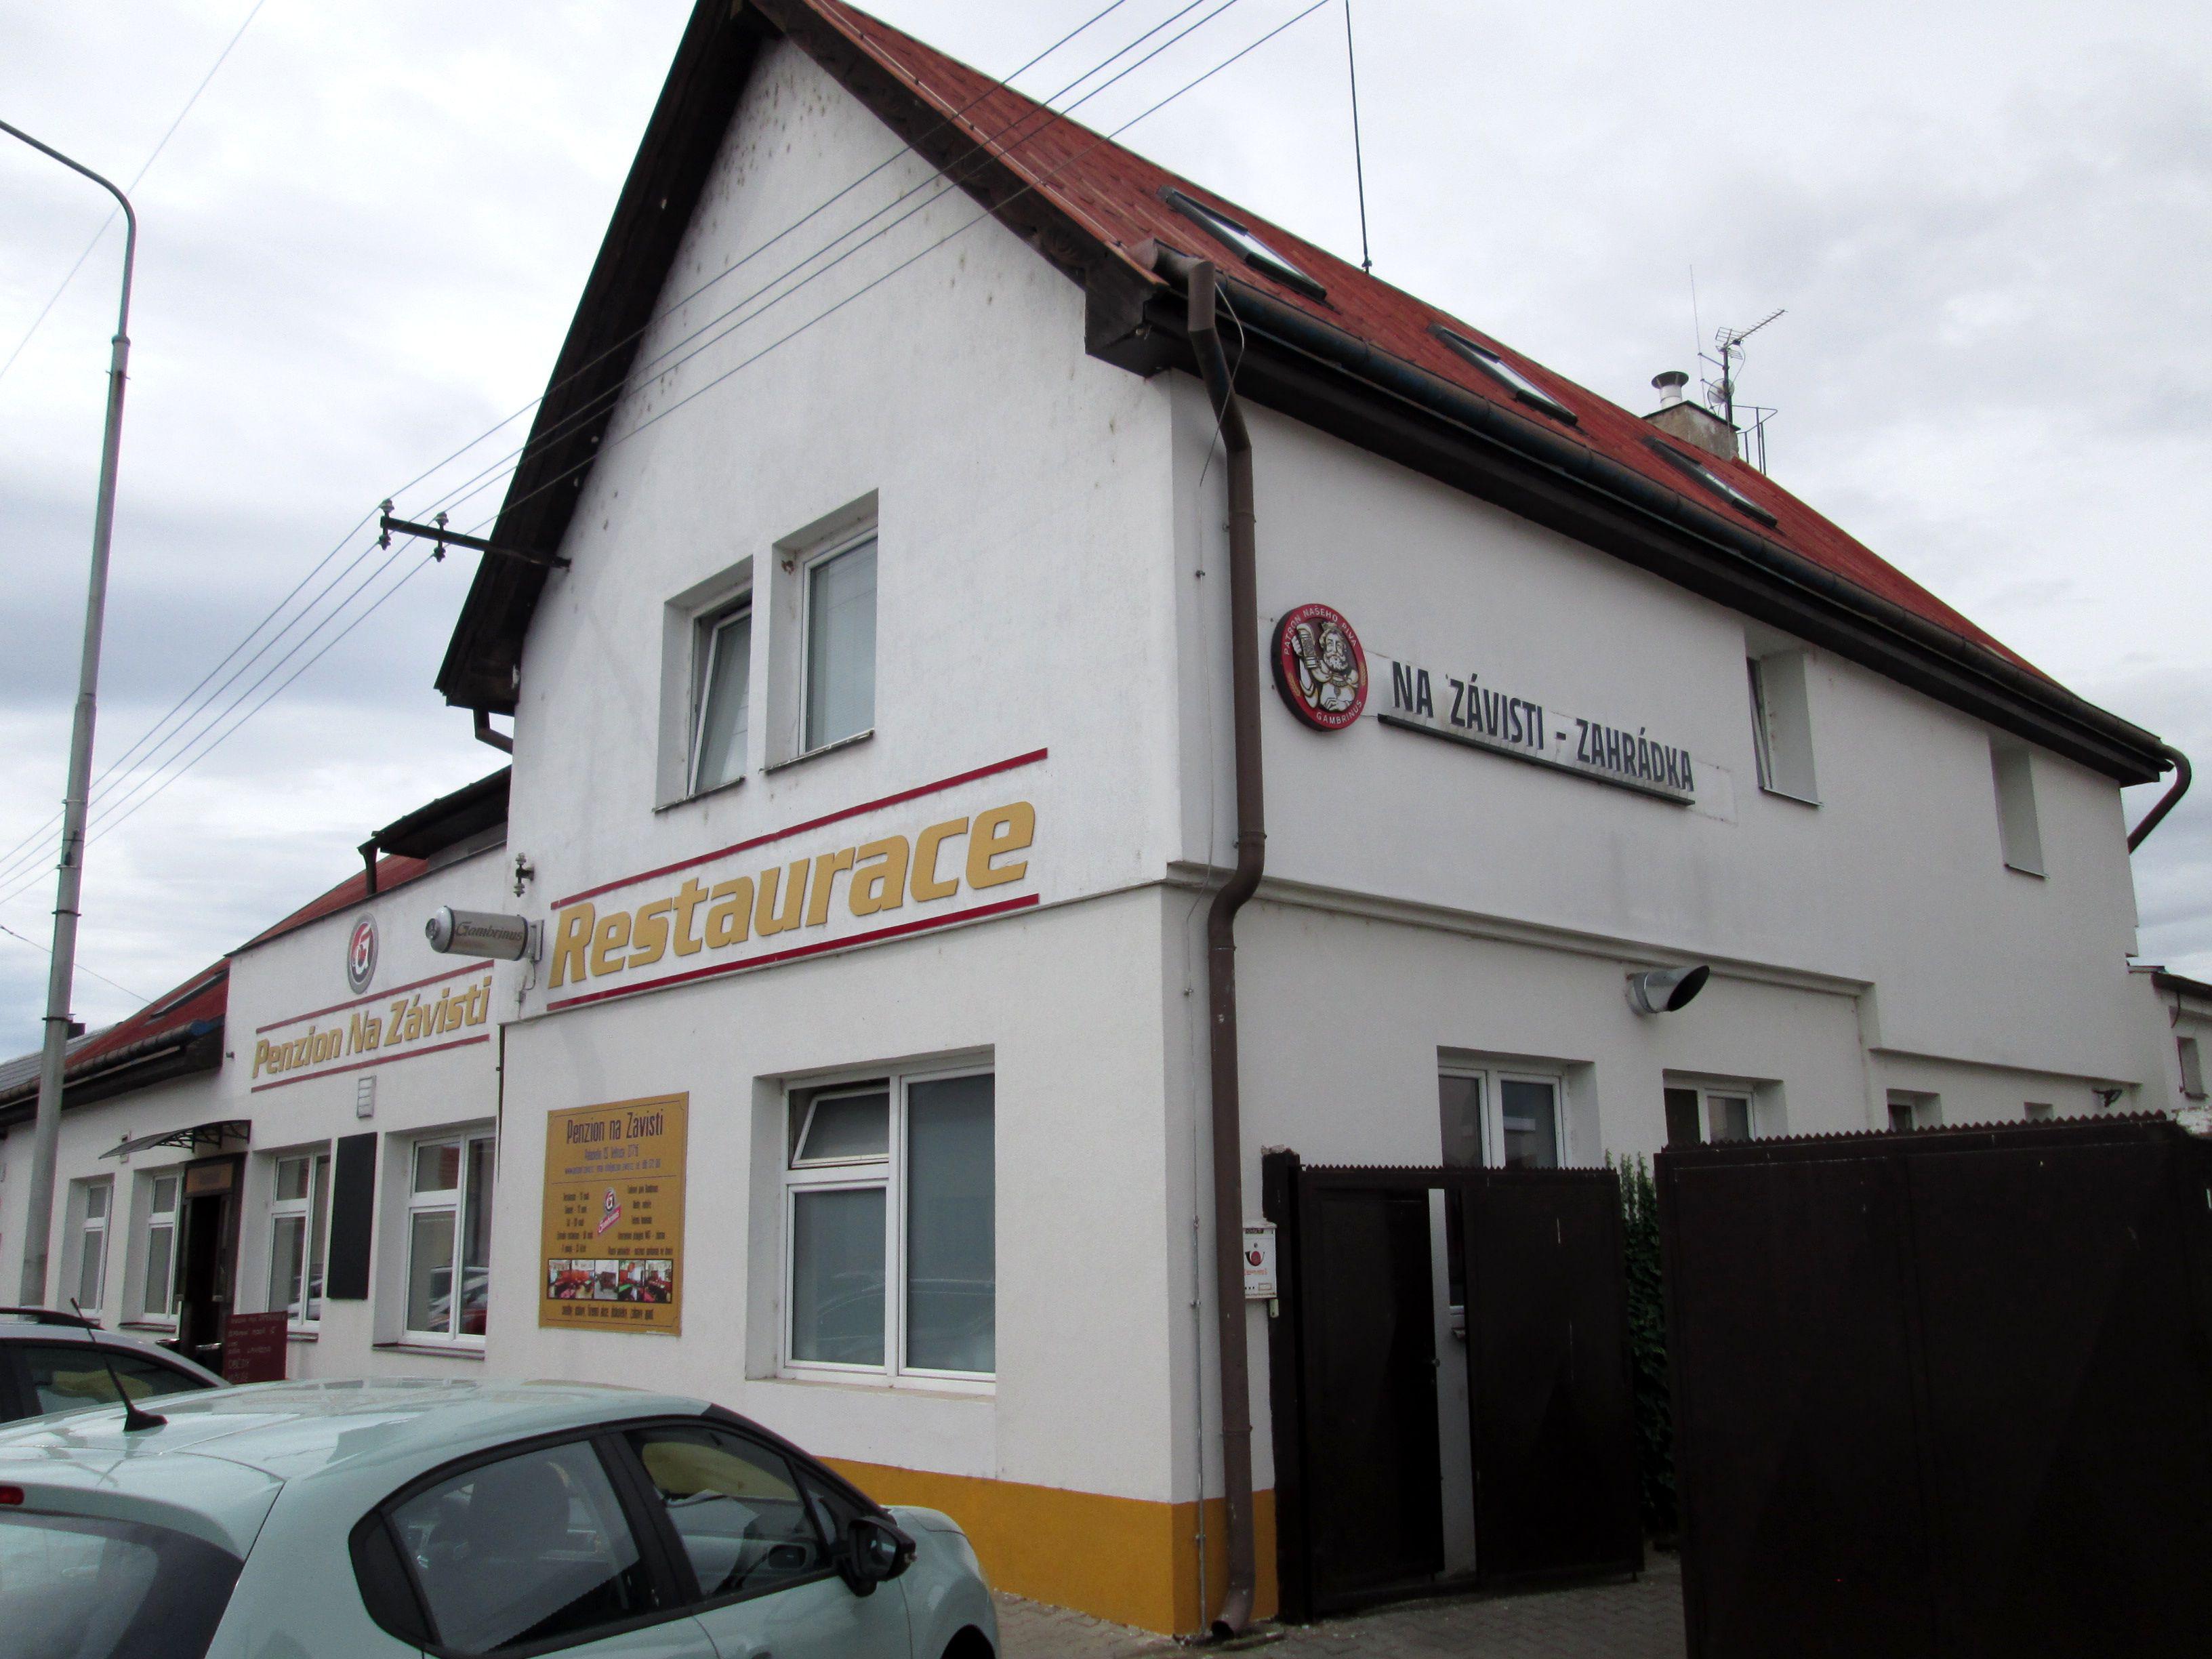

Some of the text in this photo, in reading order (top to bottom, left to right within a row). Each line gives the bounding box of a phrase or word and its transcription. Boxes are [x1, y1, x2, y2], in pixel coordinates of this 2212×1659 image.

[1284, 605, 1357, 655] PATRON NAŠEHO PIVA
[1316, 701, 1362, 724] GAMBRINUS
[1391, 661, 1434, 718] NA
[1450, 673, 1544, 750] ZÁVISTI
[1576, 718, 1695, 792] ZAHRÁDKA
[548, 800, 1036, 989] Restaurace
[455, 922, 523, 941] Gambrinus
[251, 975, 493, 1078] Penzion Na Závisti
[567, 1117, 605, 1144] Penzion
[609, 1120, 621, 1140] na
